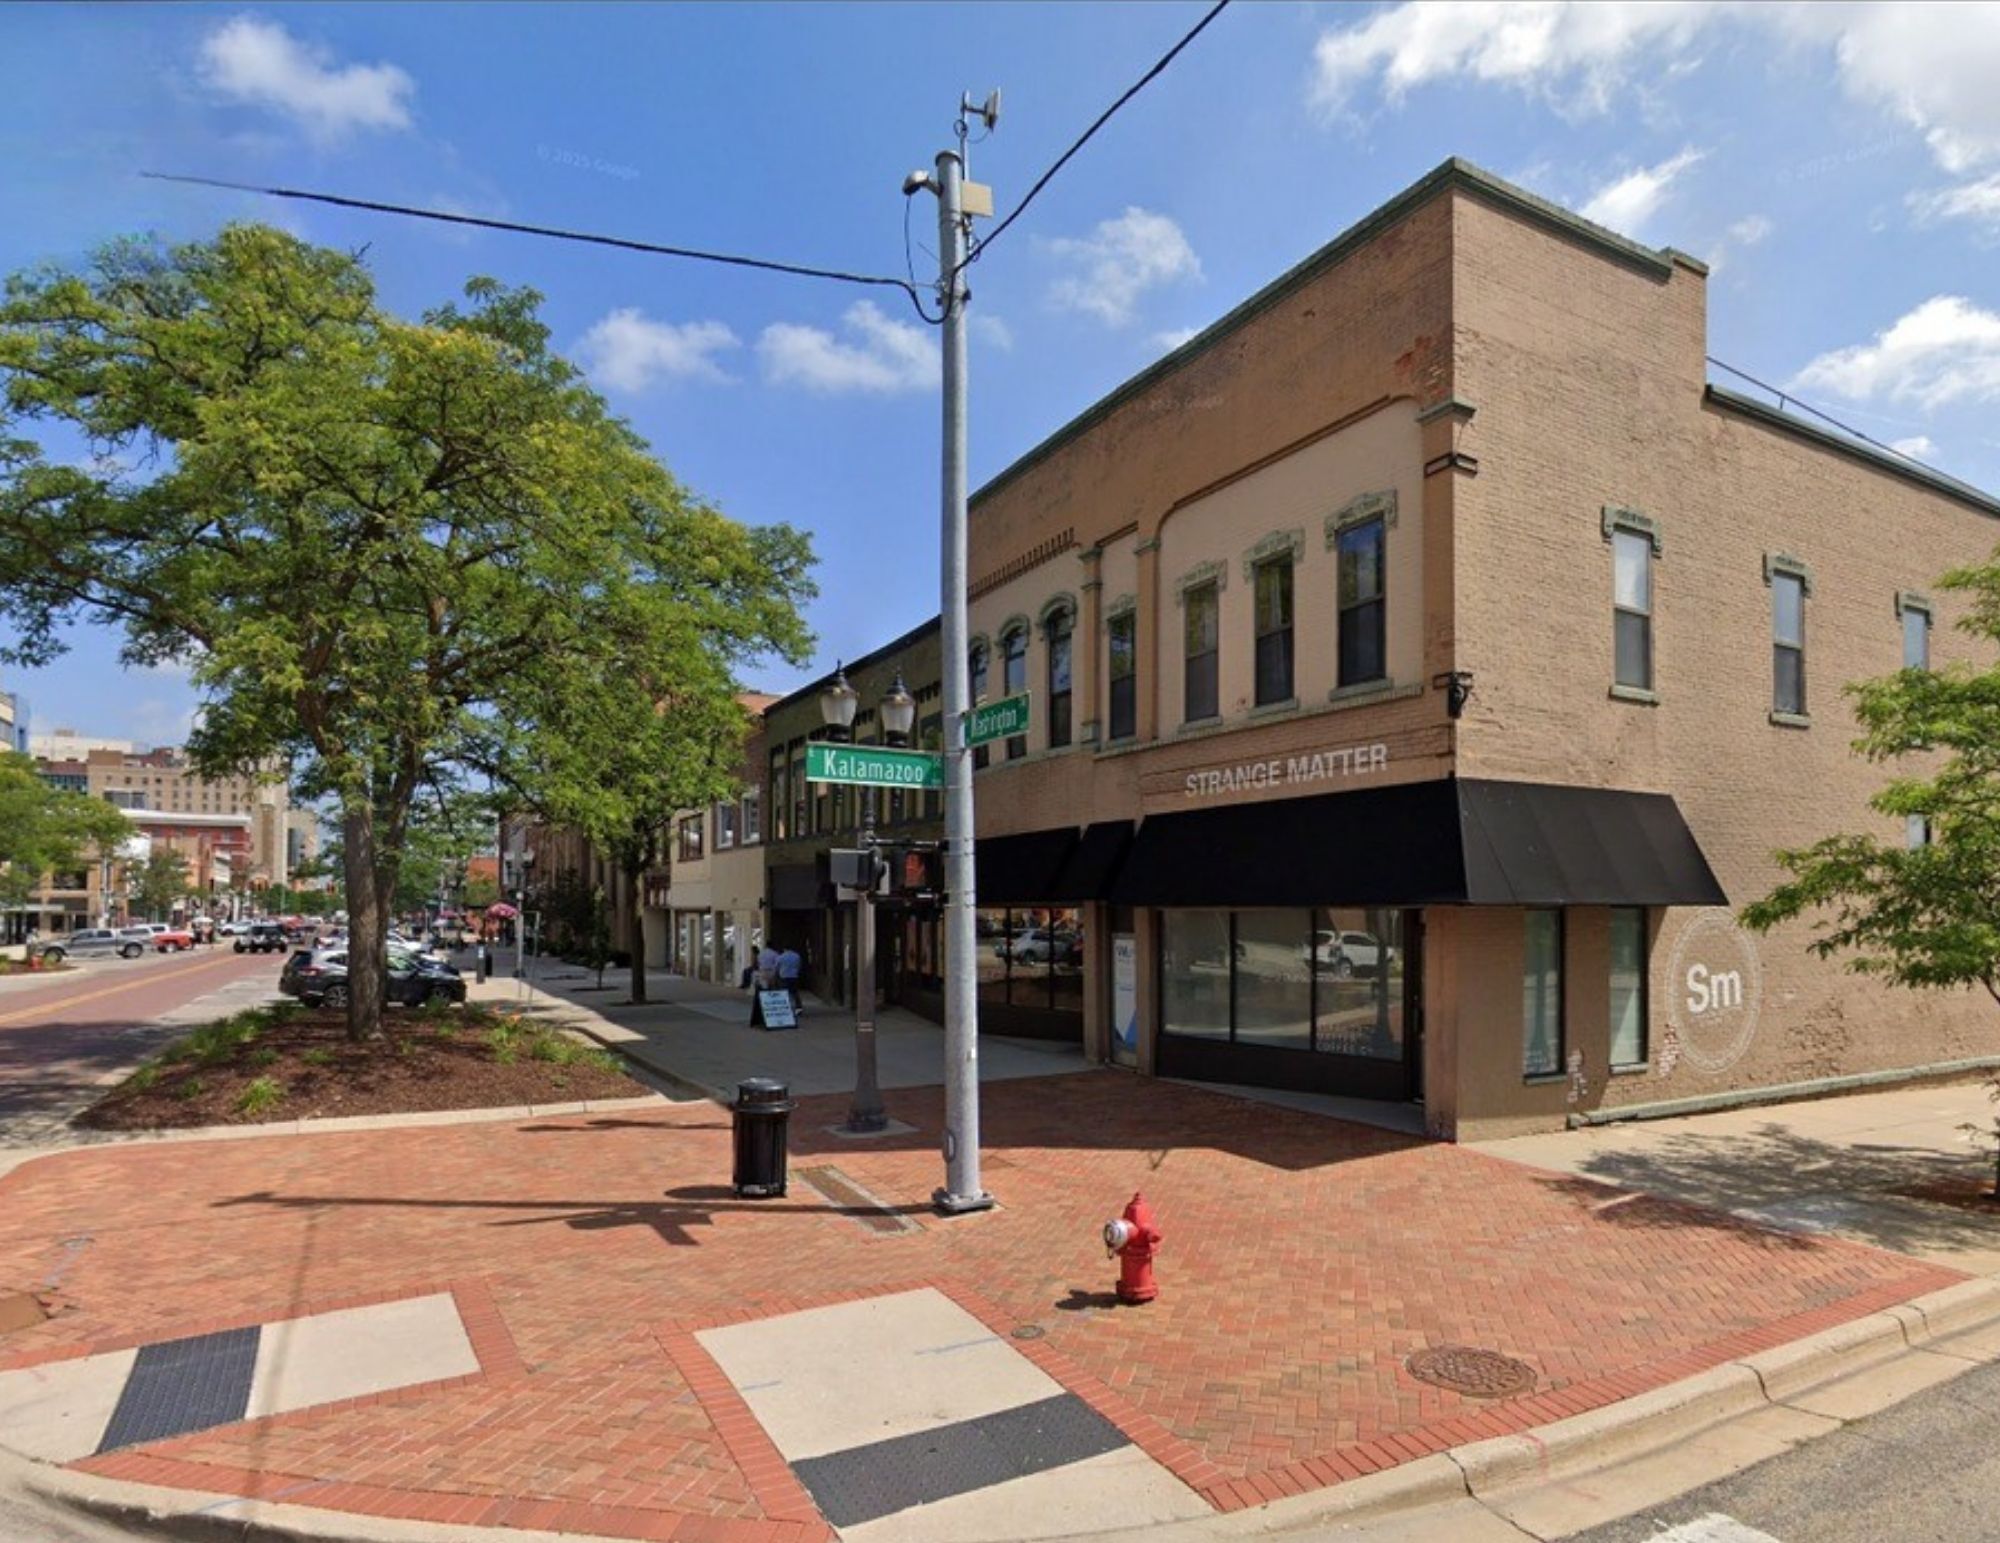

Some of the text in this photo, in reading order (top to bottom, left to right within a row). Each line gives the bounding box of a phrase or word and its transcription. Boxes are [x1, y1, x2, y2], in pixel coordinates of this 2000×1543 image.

[824, 748, 924, 782] Kalamazoo
[1184, 743, 1388, 798] STRANGE MATTER
[1686, 962, 1743, 1014] Sm
